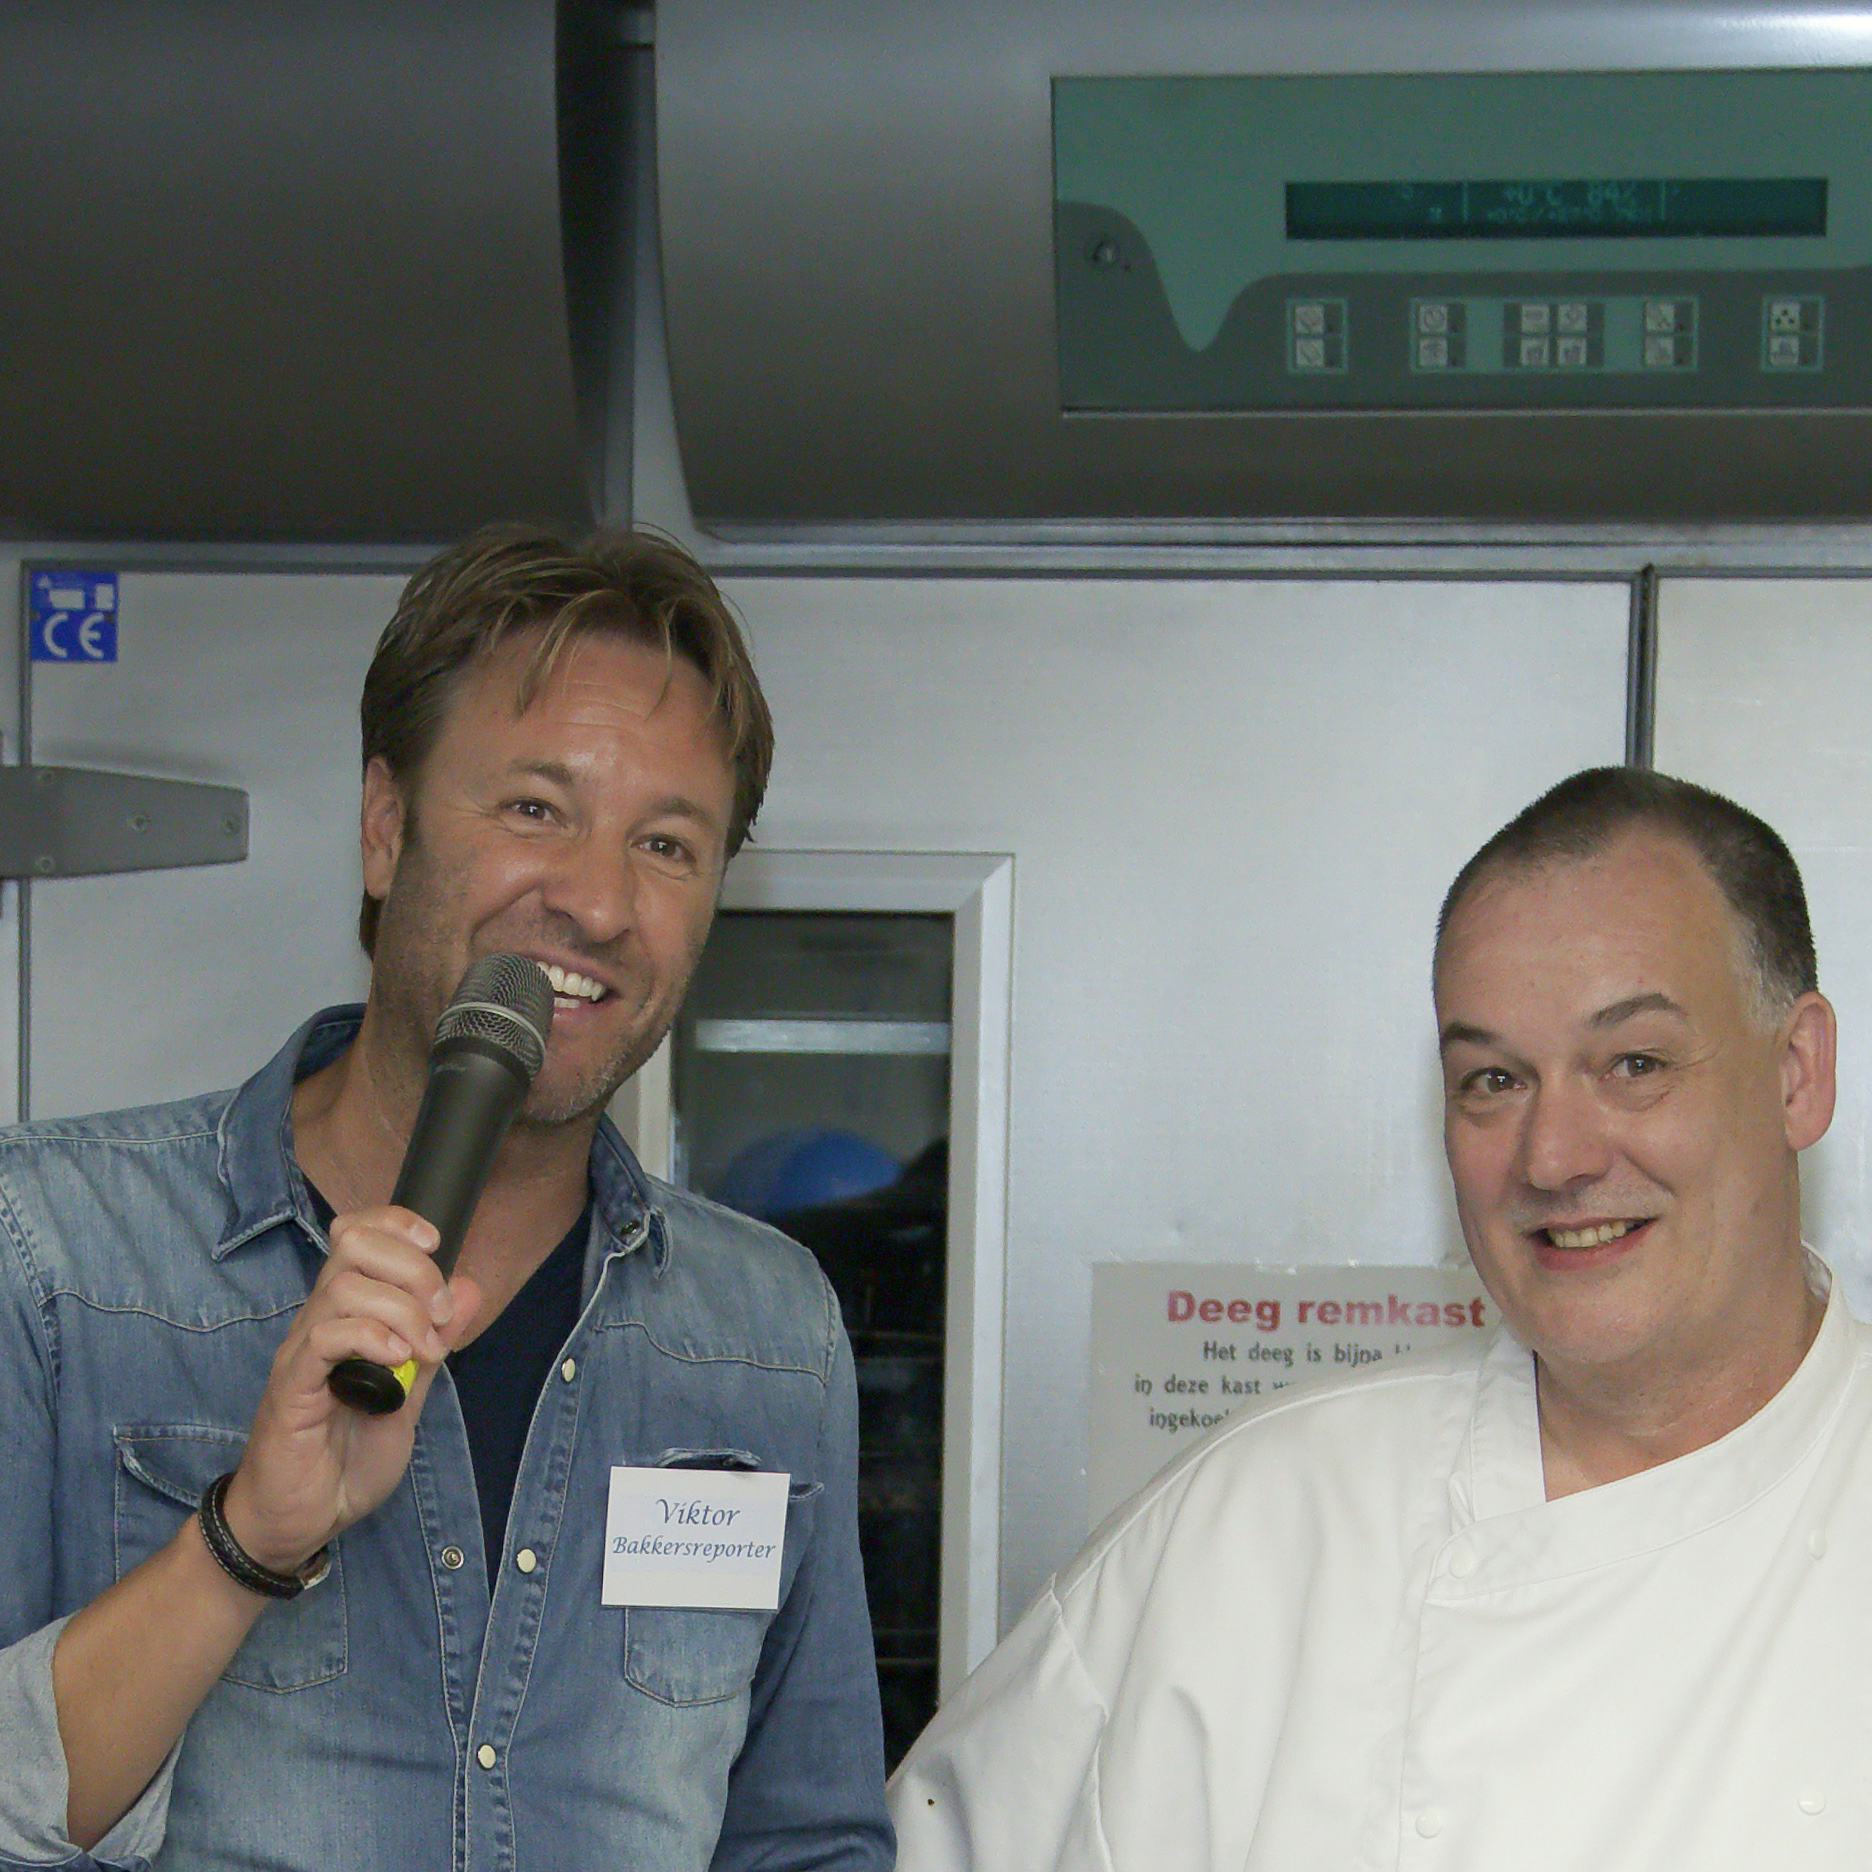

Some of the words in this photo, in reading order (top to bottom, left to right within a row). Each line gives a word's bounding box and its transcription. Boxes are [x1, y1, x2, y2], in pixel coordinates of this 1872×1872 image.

[1167, 1290, 1281, 1332] Deeg
[1297, 1294, 1486, 1328] remkast
[1202, 1341, 1237, 1361] Het
[1248, 1341, 1294, 1367] deeg
[1306, 1343, 1322, 1363] is
[1334, 1343, 1383, 1368] bijna
[1134, 1374, 1153, 1396] in
[1164, 1374, 1209, 1394] deze
[1222, 1375, 1261, 1395] kast
[1149, 1408, 1231, 1434] ingekoe
[656, 1498, 741, 1526] Viktor
[612, 1536, 776, 1564] Bakkersreporter
